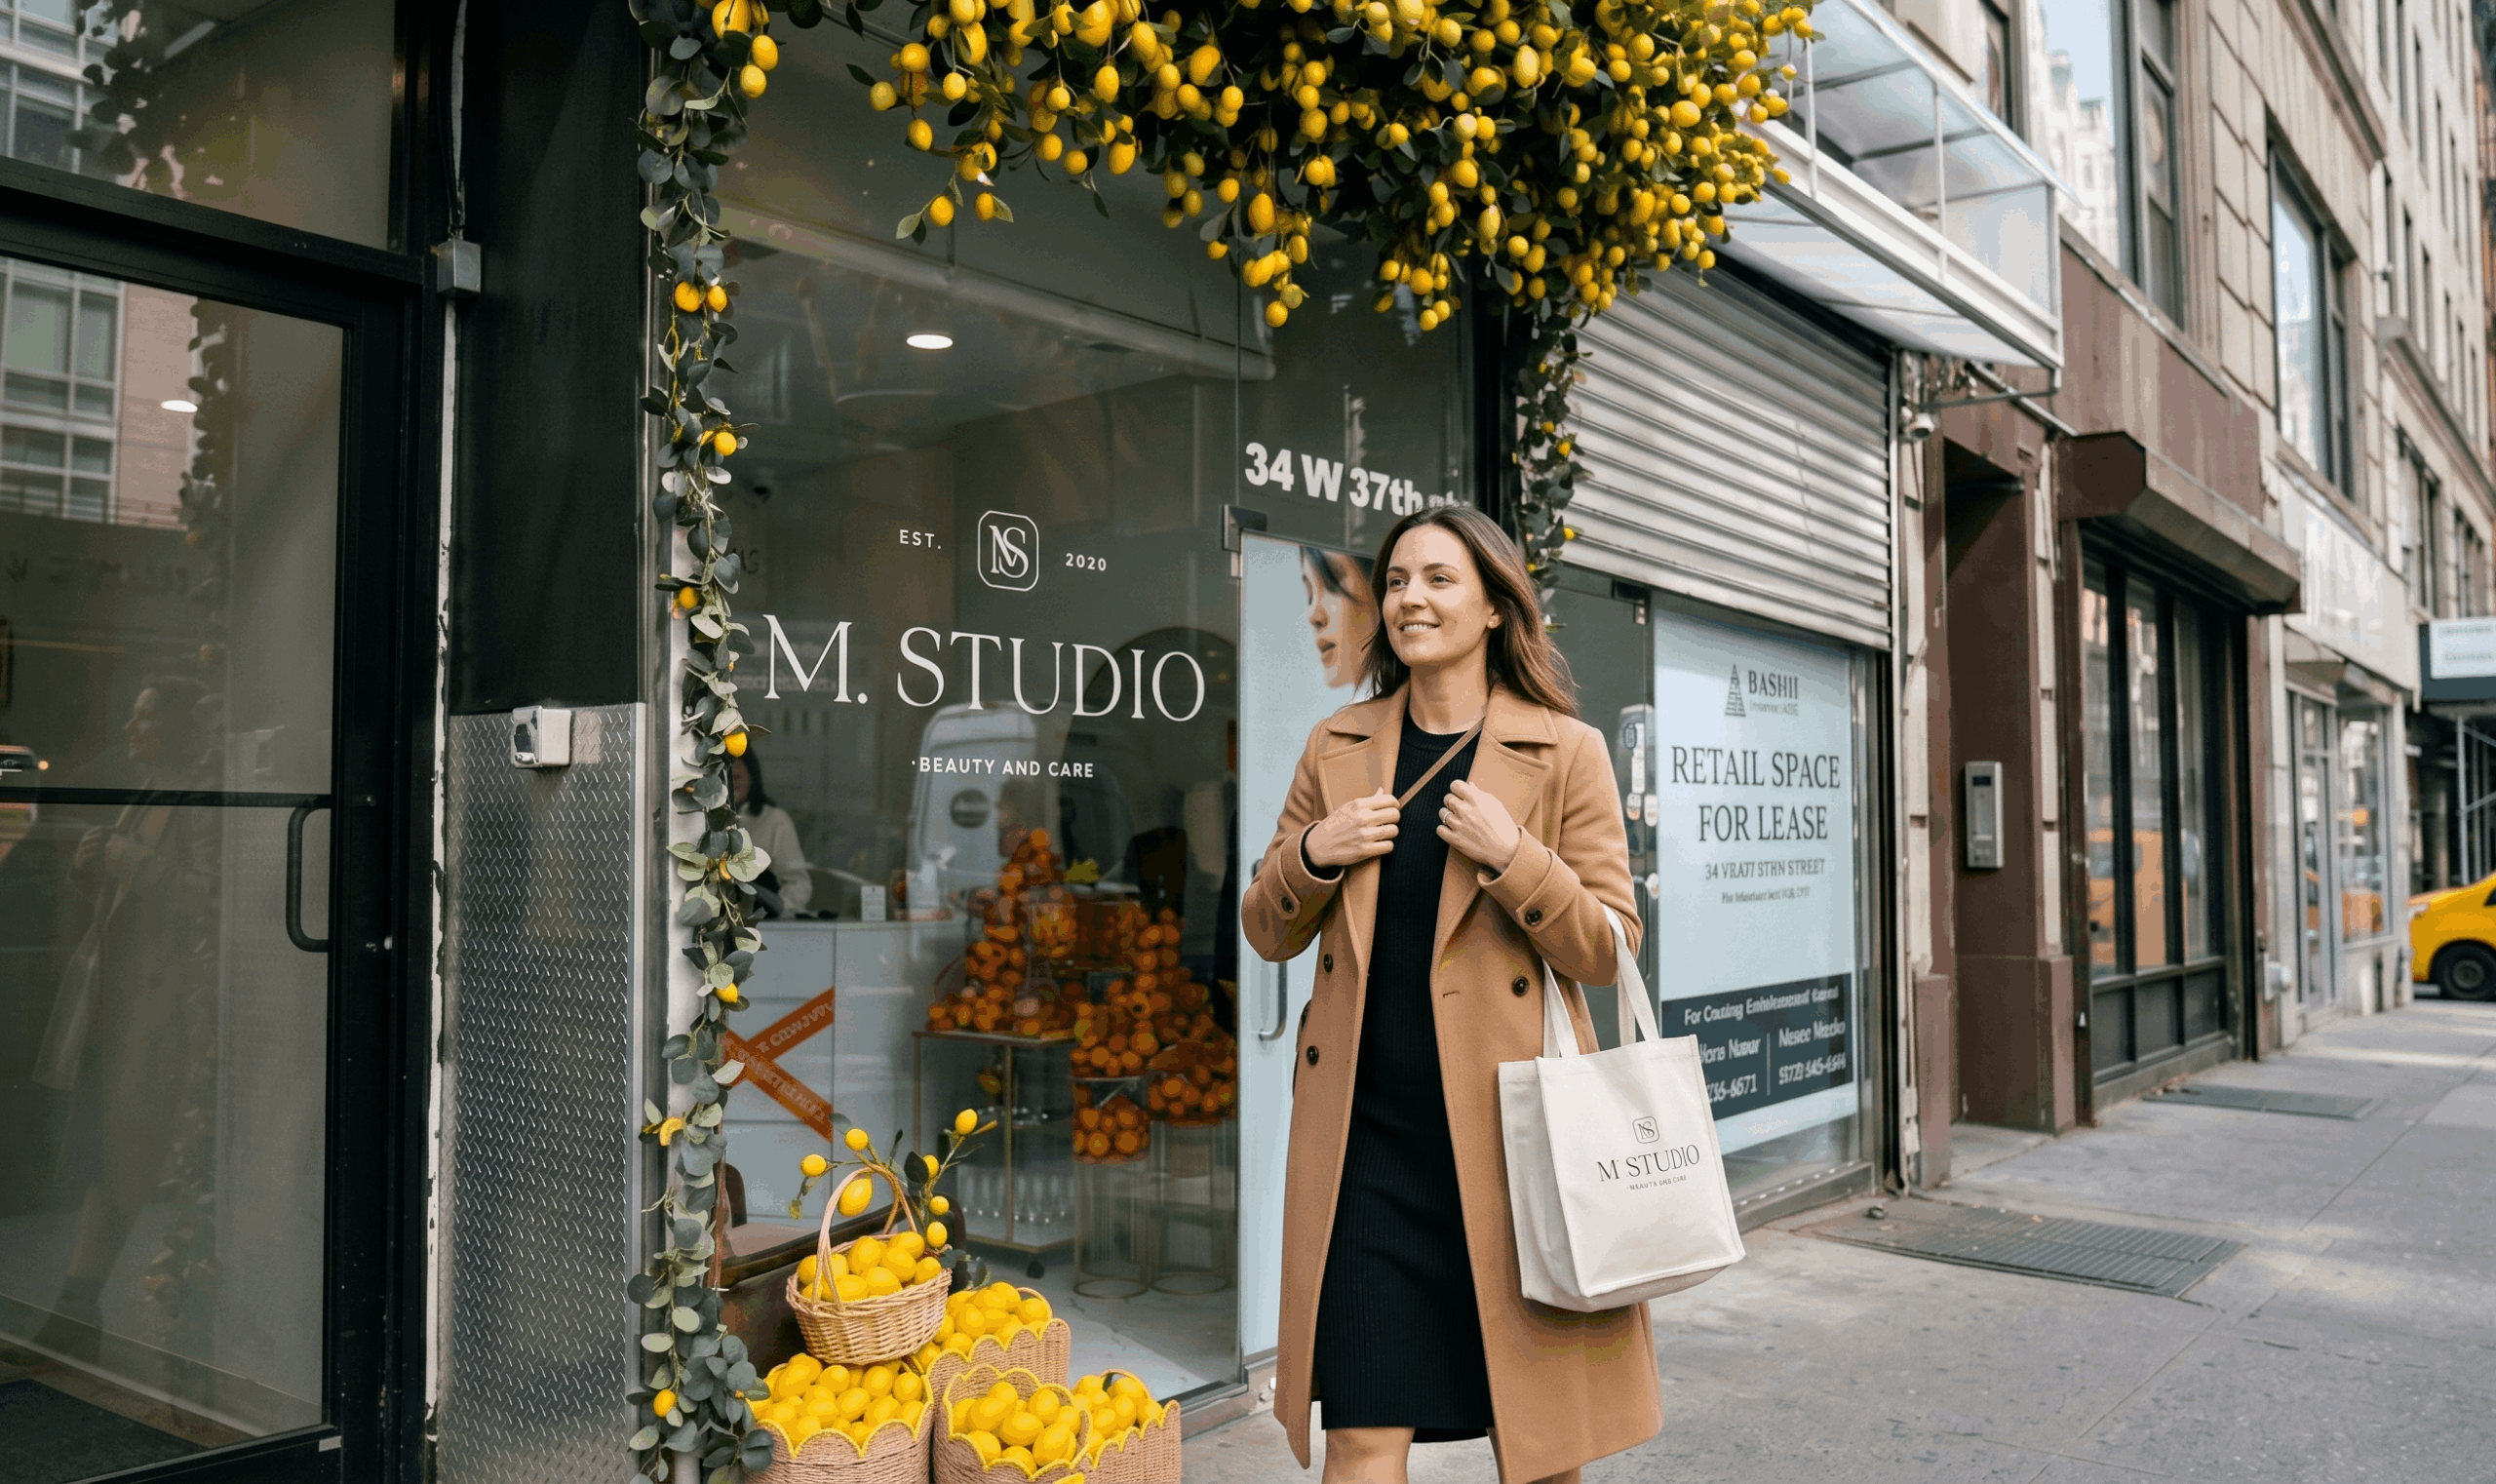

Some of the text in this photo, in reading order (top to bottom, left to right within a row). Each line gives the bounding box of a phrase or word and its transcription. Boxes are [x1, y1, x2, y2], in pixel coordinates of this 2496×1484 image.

[1245, 442, 1424, 517] 34 W 37th
[899, 528, 942, 551] EST.
[1065, 552, 1108, 572] 2020
[762, 614, 1205, 722] M. STUDIO
[1002, 760, 1040, 776] AND
[1048, 762, 1094, 778] CARE
[1671, 745, 1841, 789] RETAIL SPACE
[1698, 804, 1828, 841] FOR LEASE
[1705, 863, 1718, 880] 34
[1788, 858, 1825, 876] STREET
[1684, 1008, 1701, 1026] For
[1625, 1144, 1700, 1177] STUDIO
